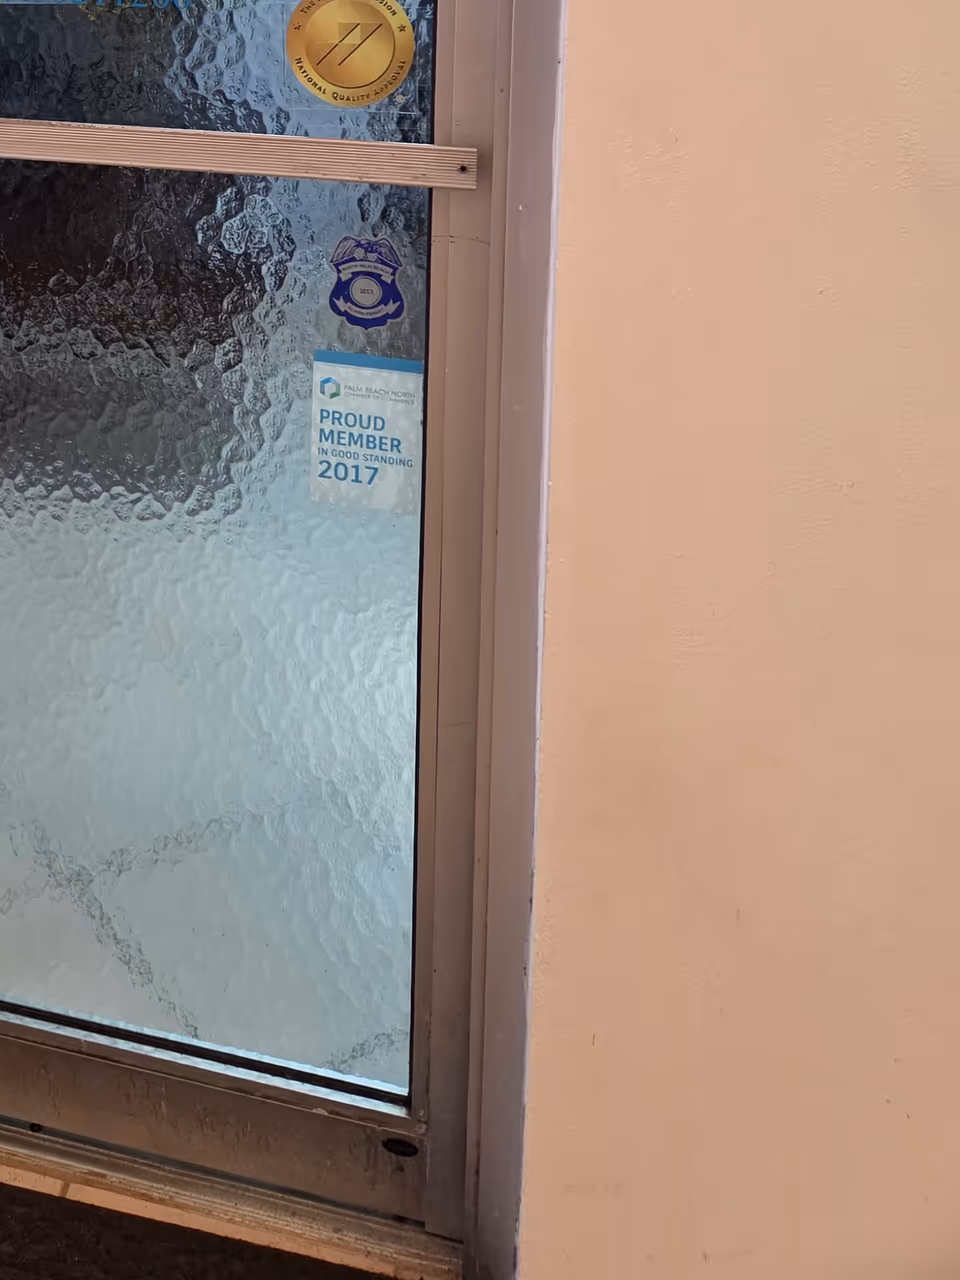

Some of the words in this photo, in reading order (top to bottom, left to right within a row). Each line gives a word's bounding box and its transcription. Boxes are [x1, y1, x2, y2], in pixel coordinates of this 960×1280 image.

[294, 57, 326, 95] NATIONAL
[332, 92, 371, 102] QUALITY
[374, 60, 406, 96] APPROVAL
[344, 384, 364, 393] PALM
[366, 387, 390, 396] BEACH
[390, 390, 416, 400] NORTH
[320, 408, 386, 432] PROUD
[319, 428, 402, 454] MEMBER
[318, 448, 328, 456] IN
[330, 449, 360, 460] GOOD
[362, 454, 414, 468] STANDING
[318, 460, 379, 486] 2017
